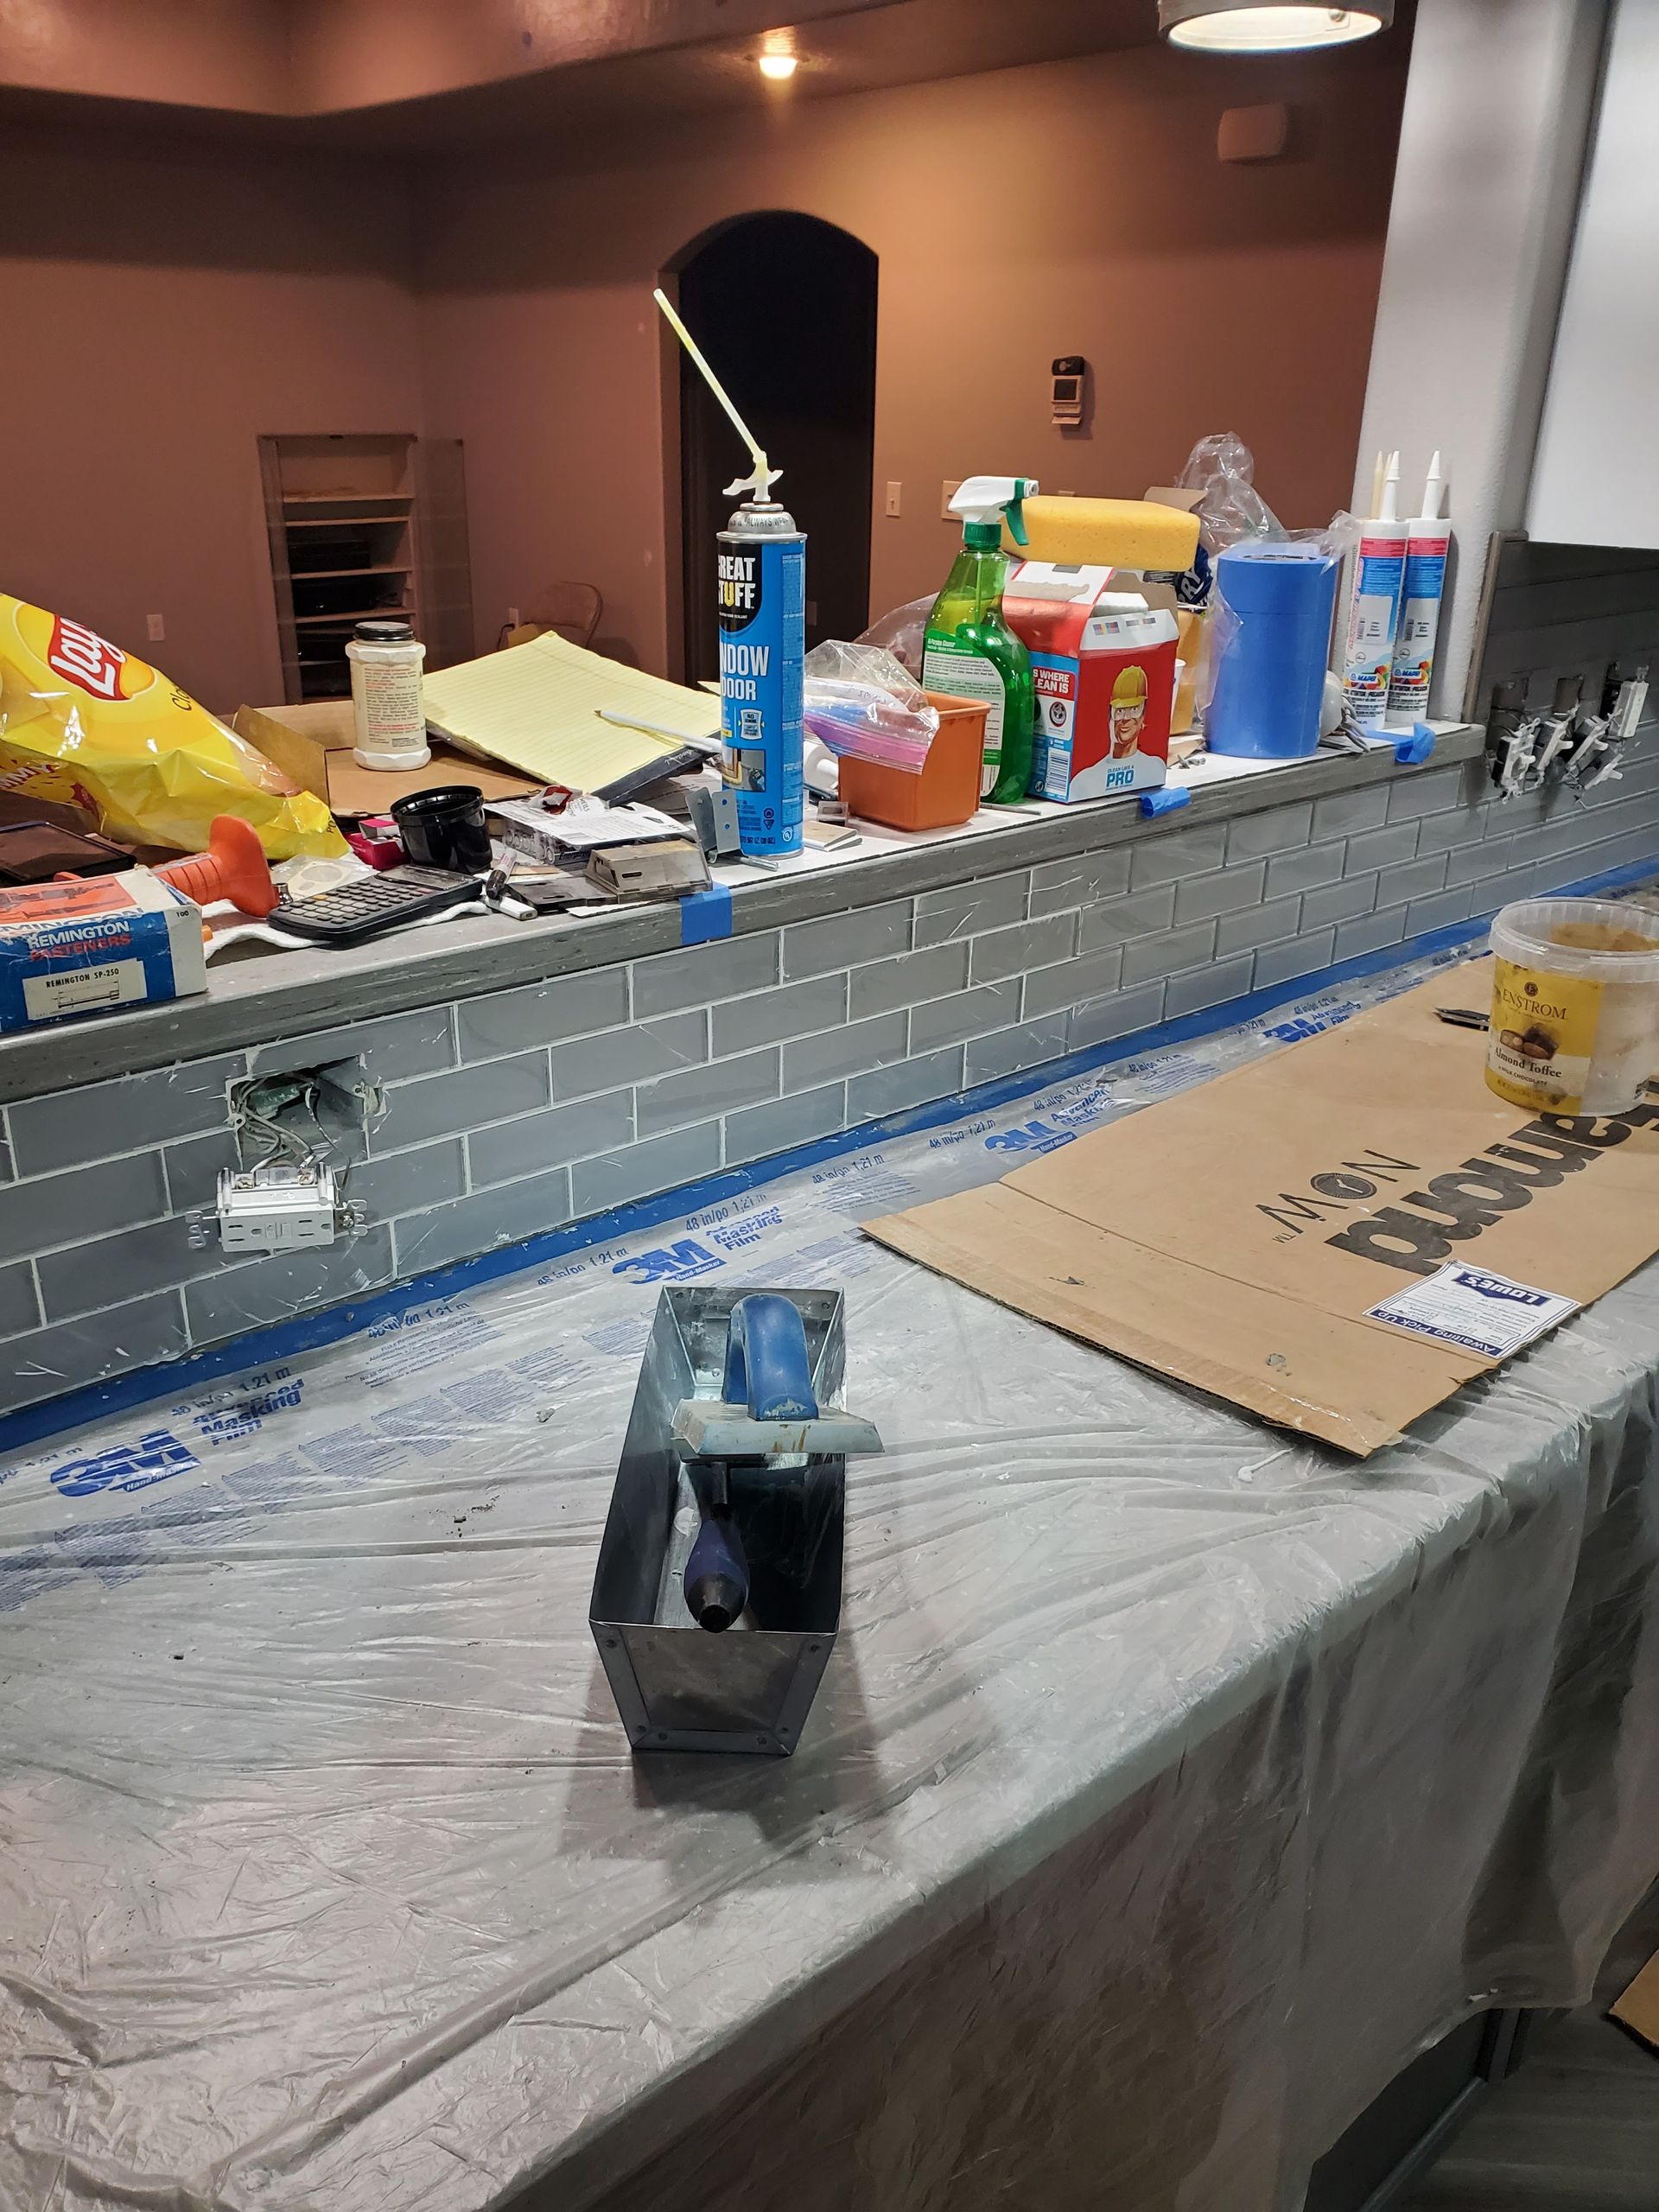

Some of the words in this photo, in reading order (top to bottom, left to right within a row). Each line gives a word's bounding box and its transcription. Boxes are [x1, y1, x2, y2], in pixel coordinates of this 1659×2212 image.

[718, 580, 756, 609] TUFF
[50, 616, 126, 697] Lay
[720, 642, 770, 677] NDOW
[721, 676, 757, 701] DOOR
[1035, 678, 1058, 692] EAN
[1058, 683, 1069, 694] IS
[1039, 670, 1070, 683] WHERE
[1106, 769, 1135, 788] PRO
[175, 910, 189, 918] 100
[28, 920, 130, 950] REMINGTON
[29, 933, 132, 962] FASTENERS
[46, 974, 91, 988] REMINGTON
[93, 968, 120, 981] SP-250
[1503, 988, 1568, 1020] ENSTROM
[1495, 1046, 1526, 1070] Almond
[1529, 1060, 1563, 1078] Toffee
[685, 1217, 700, 1231] 48
[700, 1207, 729, 1228] in/po
[723, 1232, 762, 1251] Film
[612, 1238, 715, 1285] 3M
[1377, 1311, 1399, 1323] Up
[1399, 1316, 1431, 1333] Pick
[1433, 1327, 1497, 1354] Awaiting
[201, 1389, 302, 1434] Masking
